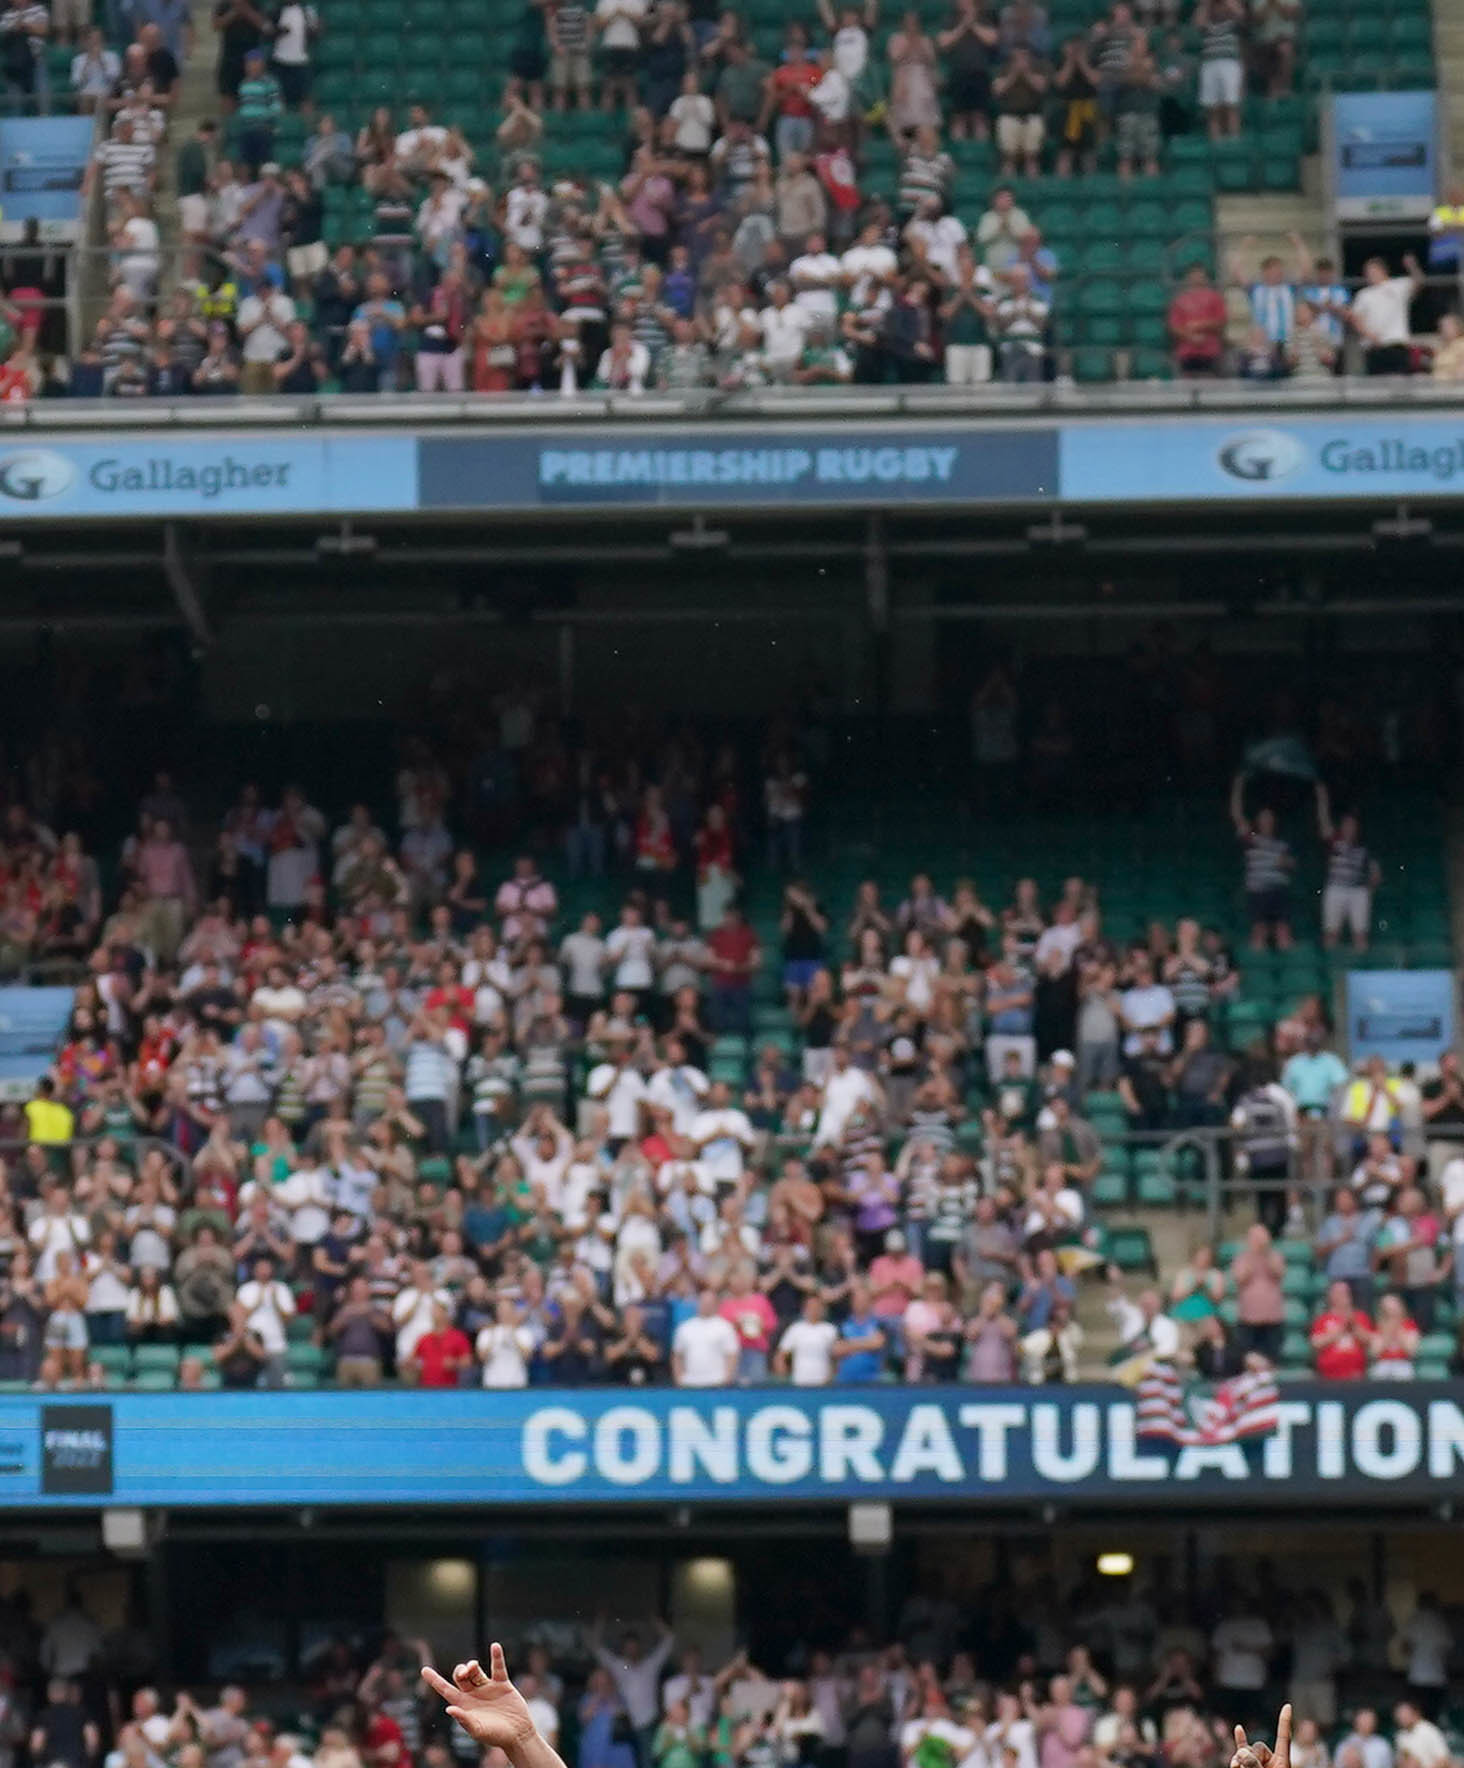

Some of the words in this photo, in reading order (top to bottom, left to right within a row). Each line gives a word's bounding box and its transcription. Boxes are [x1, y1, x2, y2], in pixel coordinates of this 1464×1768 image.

[90, 455, 292, 498] Gallagher
[540, 450, 807, 486] PREMIERSHIP
[816, 446, 958, 483] RUGBY
